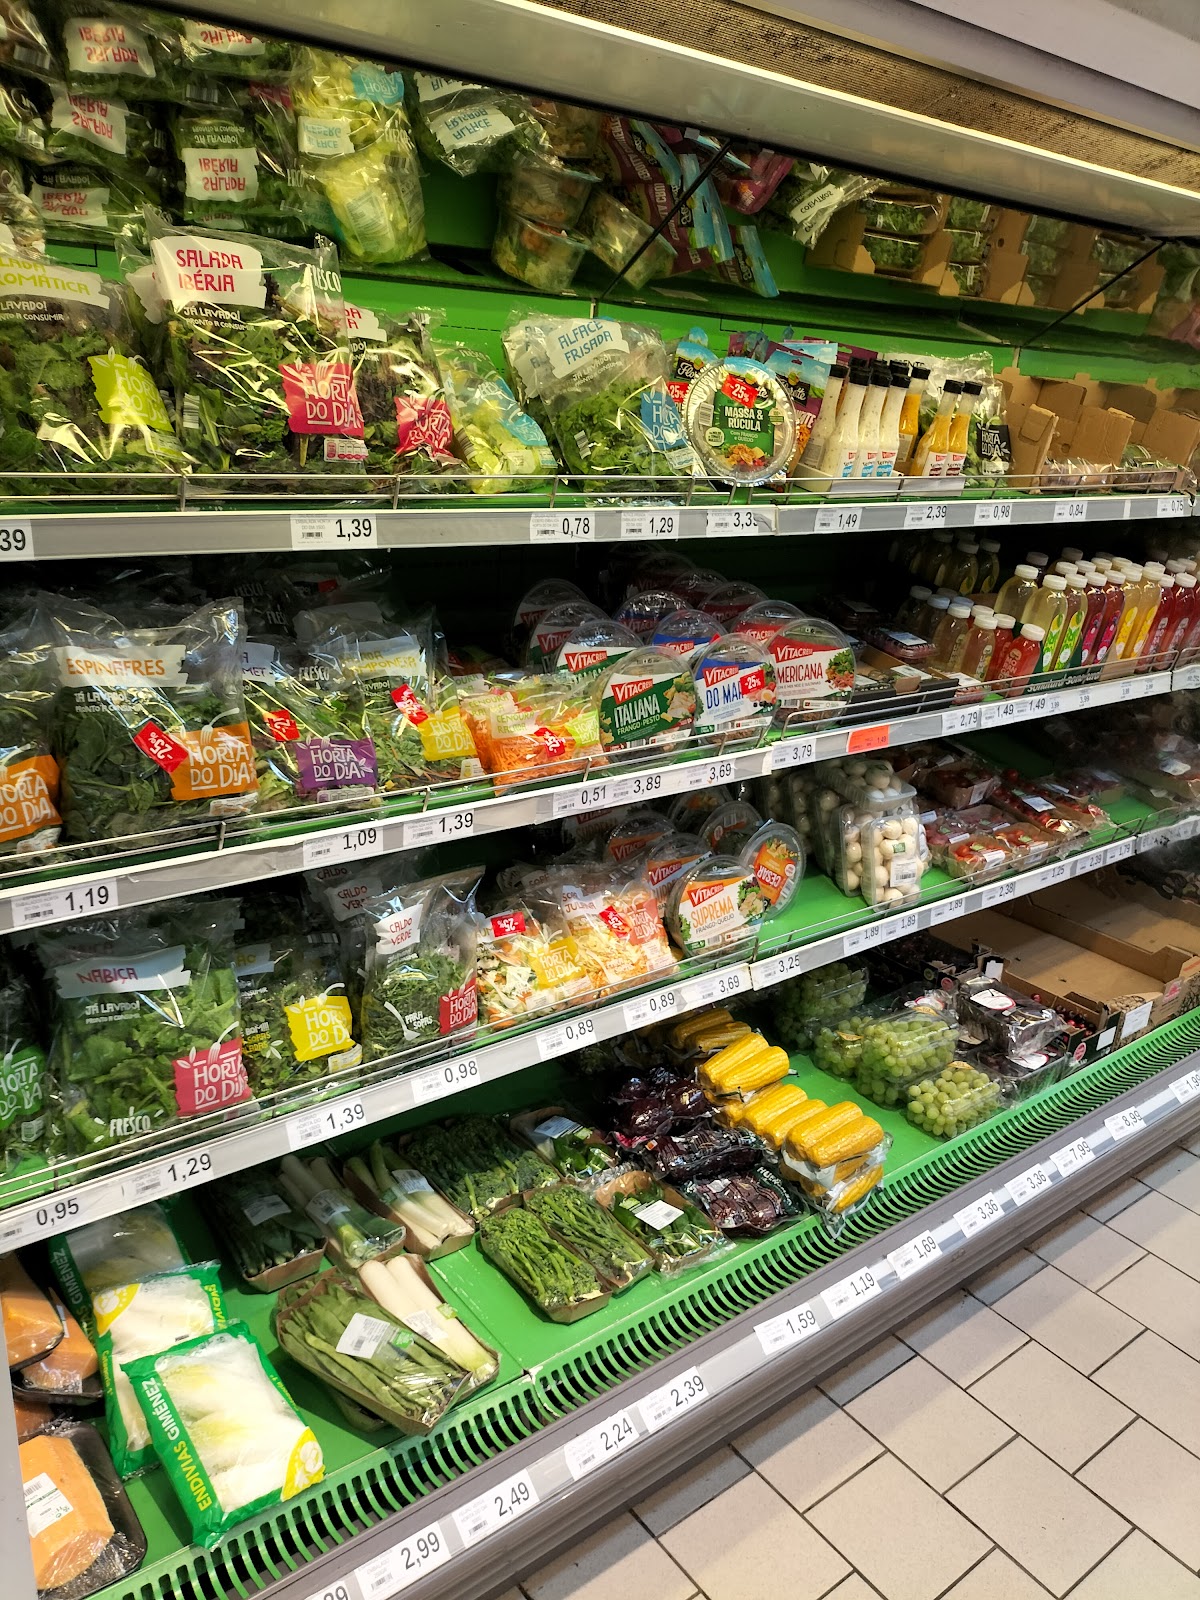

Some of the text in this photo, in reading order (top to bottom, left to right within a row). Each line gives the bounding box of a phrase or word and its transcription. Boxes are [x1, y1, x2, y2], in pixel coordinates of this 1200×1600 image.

[0, 256, 46, 273] LADA
[175, 248, 244, 270] SALADA
[177, 267, 236, 293] IBÉRIA
[183, 306, 242, 321] JÁ LAVADO!
[557, 320, 604, 350] ALFACE
[563, 330, 614, 365] FRISADA
[729, 382, 751, 404] -25%
[305, 400, 328, 420] DO
[724, 406, 764, 421] MASSA &
[727, 415, 762, 432] RÚCULA
[981, 430, 1001, 444] HORTA
[926, 505, 947, 520] 2,39
[993, 504, 1011, 519] 0,98
[1068, 504, 1084, 517] 0,84
[1171, 499, 1184, 513] 0,75
[335, 518, 372, 541] 1,39
[562, 517, 590, 538] 0,78
[649, 517, 674, 536] 1,29
[733, 511, 758, 529] 3,3
[838, 513, 859, 530] 1,49
[776, 645, 814, 662] VITACRESS
[67, 658, 166, 677] ESPINAFRES
[704, 667, 740, 686] VITACRESS
[777, 662, 824, 684] MERICANA
[613, 679, 654, 704] VITACRESS
[744, 675, 762, 690] -25%
[705, 687, 719, 710] DO
[1028, 698, 1046, 713] 1,49
[496, 711, 535, 723] CENOURA
[613, 693, 662, 729] ITALIANA
[960, 711, 978, 728] 2,79
[997, 703, 1014, 719] 1,49
[148, 731, 174, 761] -25%
[435, 734, 452, 750] DO
[188, 743, 250, 768] HORTA
[311, 748, 359, 764] HORTA
[792, 744, 813, 762] 3,79
[190, 766, 214, 786] DO
[314, 766, 332, 779] DO
[709, 761, 732, 782] 3,69
[632, 775, 662, 795] 3,89
[581, 785, 608, 806] 0,51
[438, 812, 474, 834] 1,39
[342, 827, 377, 851] 1,09
[1119, 843, 1131, 856] 1,79
[317, 867, 348, 881] CALDO
[1052, 865, 1065, 878] 1,25
[65, 885, 109, 913] 1,19
[337, 885, 368, 899] CALDO
[689, 883, 725, 905] VITACRESS
[690, 896, 735, 929] SUPREMA
[948, 898, 963, 911] 1,89
[389, 917, 413, 934] CALDO
[496, 916, 519, 933] -25%
[607, 912, 624, 931] -25%
[631, 911, 653, 927] HORTA
[901, 914, 916, 930] 1,89
[391, 930, 412, 947] VERDE
[635, 926, 644, 938] DO
[864, 926, 880, 940] 1,89
[539, 949, 574, 967] HORTA
[778, 955, 800, 974] 3,25
[76, 966, 139, 985] NABIÇA
[545, 968, 555, 980] DO
[718, 975, 740, 994] 3,69
[450, 989, 477, 1014] HORTA
[650, 992, 675, 1012] 0,89
[405, 1010, 424, 1025] PARA
[413, 1016, 433, 1031] SOPAS
[450, 1012, 462, 1026] DO
[308, 1029, 331, 1048] DO
[565, 1019, 594, 1040] 0,89
[193, 1056, 245, 1088] HORTA
[444, 1060, 478, 1083] 0,98
[194, 1085, 217, 1107] DO
[110, 1113, 151, 1138] FRESCO
[326, 1103, 365, 1130] 1,39
[1122, 1110, 1143, 1128] 8,99
[1069, 1140, 1091, 1161] 7,99
[167, 1153, 212, 1182] 1,29
[1027, 1170, 1047, 1190] 3,36
[36, 1198, 80, 1228] 0,95
[977, 1198, 999, 1220] 3,36
[913, 1235, 937, 1259] 1,69
[850, 1272, 875, 1297] 1,19
[786, 1309, 816, 1335] 1,59
[671, 1375, 704, 1407] 2,39
[600, 1417, 633, 1450] 2,24
[141, 1377, 213, 1512] ENDIVIAS GIMÉNEZ
[495, 1482, 530, 1517] 2,49
[401, 1531, 440, 1570] 2,99
